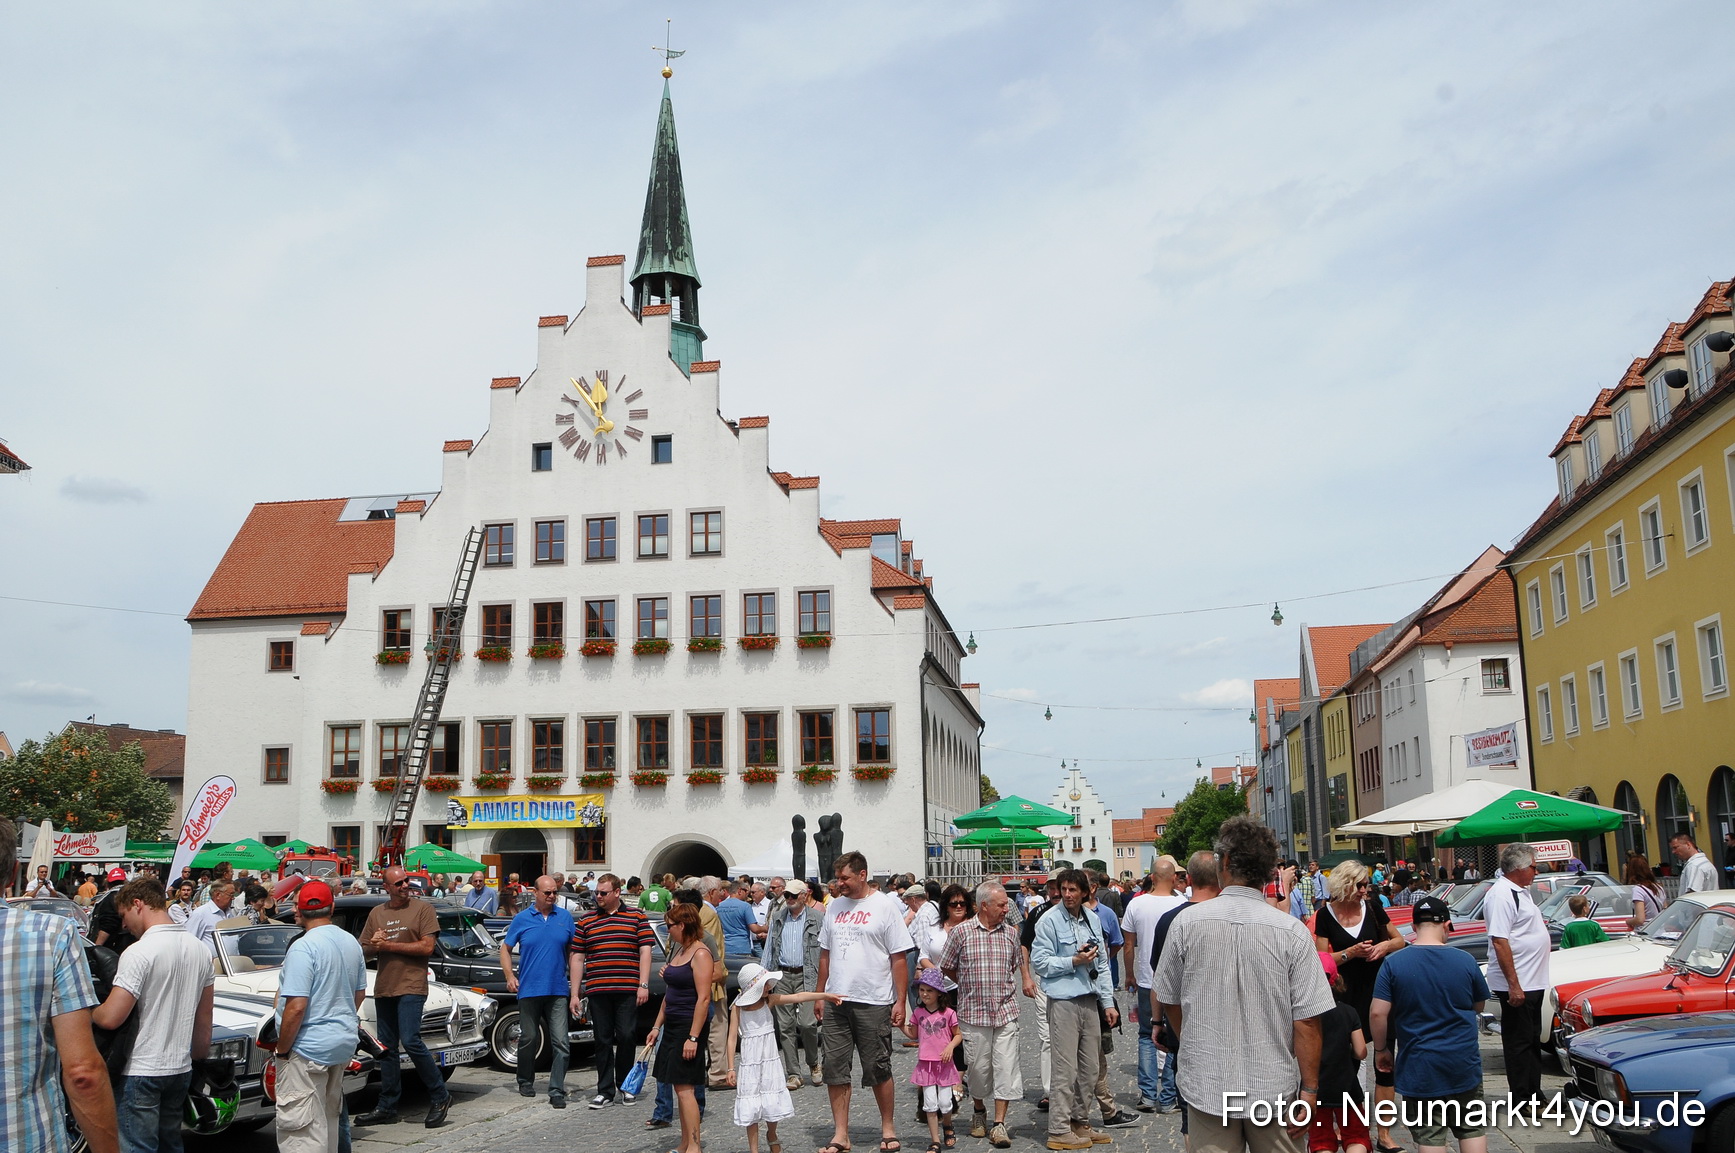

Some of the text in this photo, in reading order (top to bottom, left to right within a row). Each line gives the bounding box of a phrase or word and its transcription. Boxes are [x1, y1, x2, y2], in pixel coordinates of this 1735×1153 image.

[212, 789, 233, 815] IMBISS
[472, 801, 576, 822] ANMELDUNG
[179, 784, 220, 851] Lehmeier's
[53, 833, 97, 857] Lehmeier's
[79, 847, 97, 855] IMBISS
[649, 891, 659, 903] 6
[834, 911, 871, 924] AC/DC
